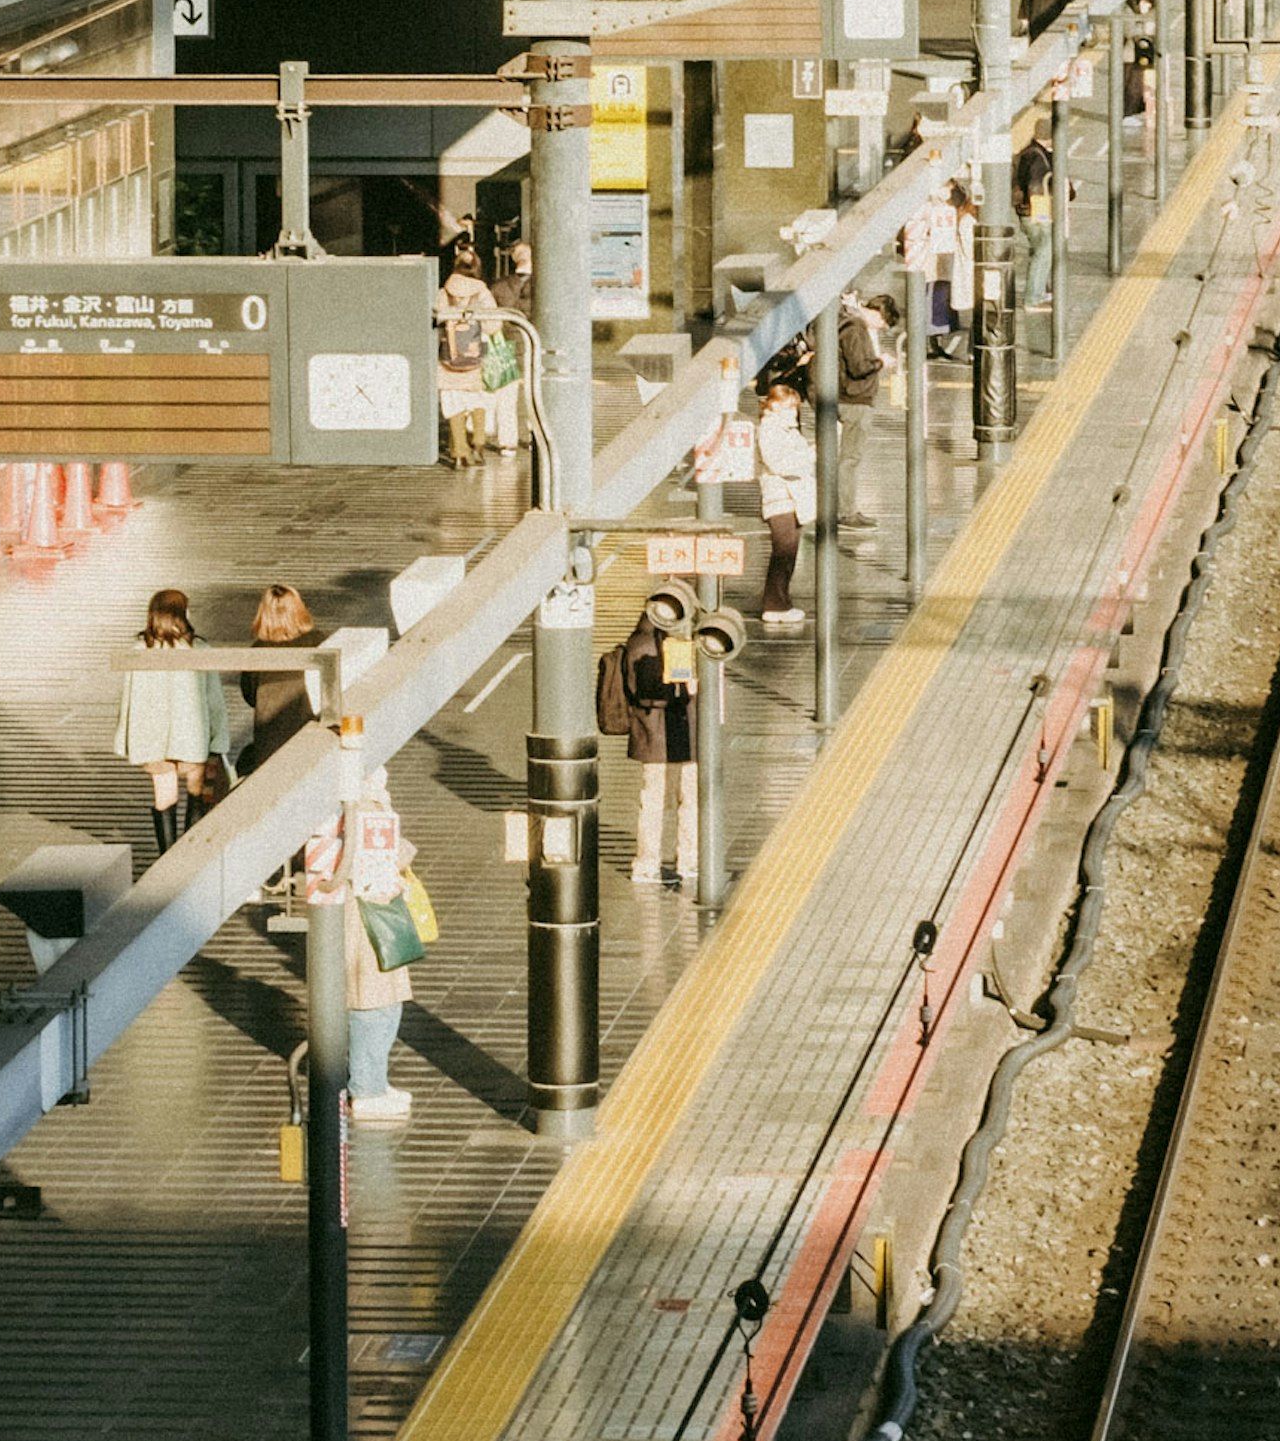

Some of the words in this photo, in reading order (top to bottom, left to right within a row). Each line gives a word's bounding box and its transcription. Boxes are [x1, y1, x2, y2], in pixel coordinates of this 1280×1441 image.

[10, 315, 31, 329] for
[34, 315, 76, 330] Fukui,
[79, 315, 156, 330] Kanazawa,
[159, 315, 213, 331] Toyama
[241, 294, 267, 331] 0
